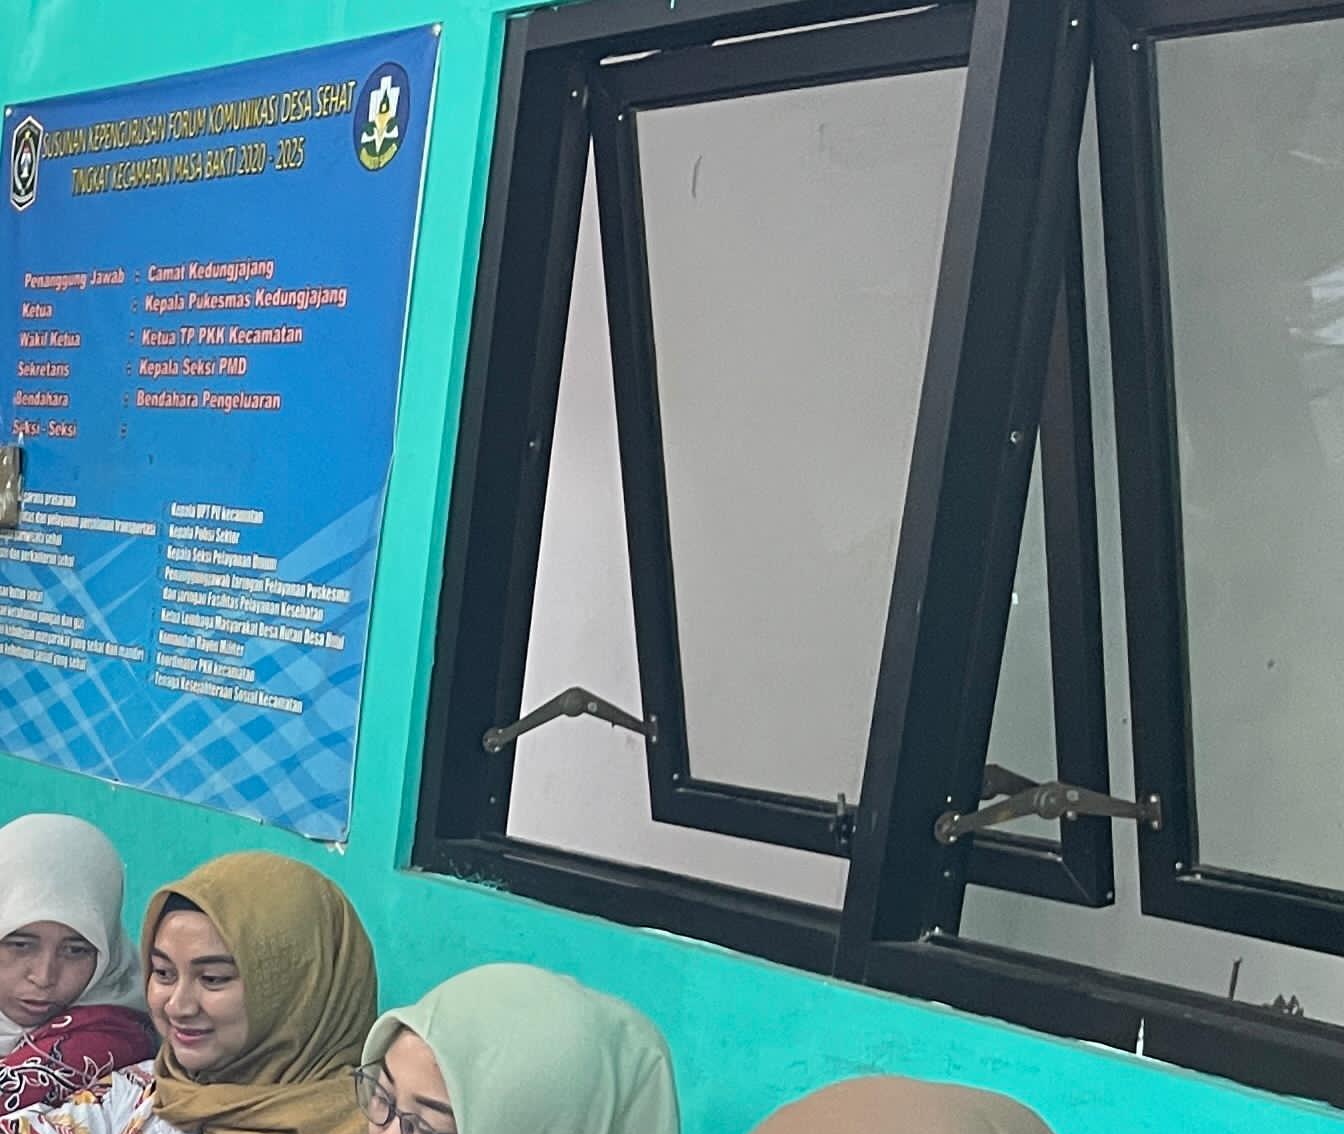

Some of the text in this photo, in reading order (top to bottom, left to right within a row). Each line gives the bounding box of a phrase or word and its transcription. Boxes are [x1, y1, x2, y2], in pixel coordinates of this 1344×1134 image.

[42, 81, 355, 159] SUSUNAN KEPENGURUSAN FORUM KOMUNIKASI DESA SEHAT
[72, 136, 305, 197] TINGKAT KECAMATAN MASA BAKTI 2020 2025
[24, 259, 274, 293] Penanggung Jawab Camat Kedungjajang
[22, 286, 348, 319] Ketua Kepala Pukesmas Kedungjajang
[19, 325, 303, 348] Wakil Ketua Ketua TP PKK Kecamatan
[17, 356, 248, 379] Sekretaris Kepala Seksi PMD
[14, 389, 281, 412] Bendahara Bendahara Pengeluaran
[13, 419, 77, 438] Seksi Seksi
